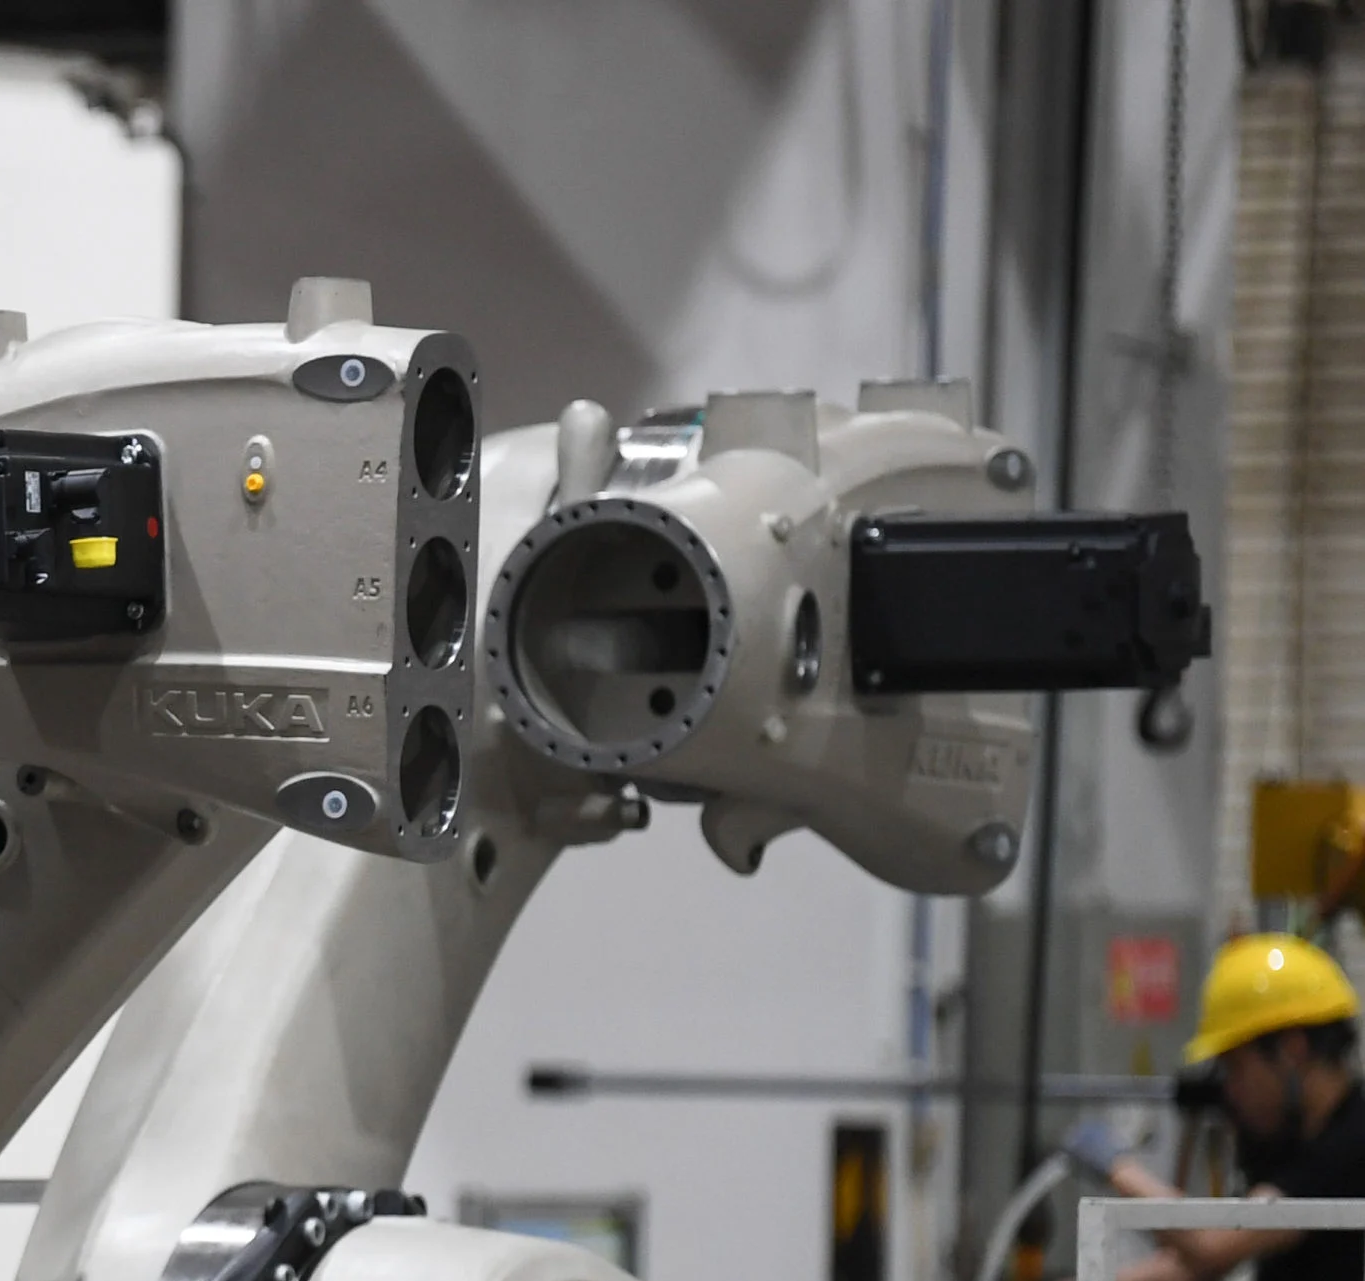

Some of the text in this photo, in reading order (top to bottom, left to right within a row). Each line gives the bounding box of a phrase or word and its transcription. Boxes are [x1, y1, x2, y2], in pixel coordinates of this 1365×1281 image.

[358, 460, 387, 483] A4
[352, 577, 381, 600] A5
[148, 689, 325, 736] KUKA
[346, 695, 374, 718] A6
